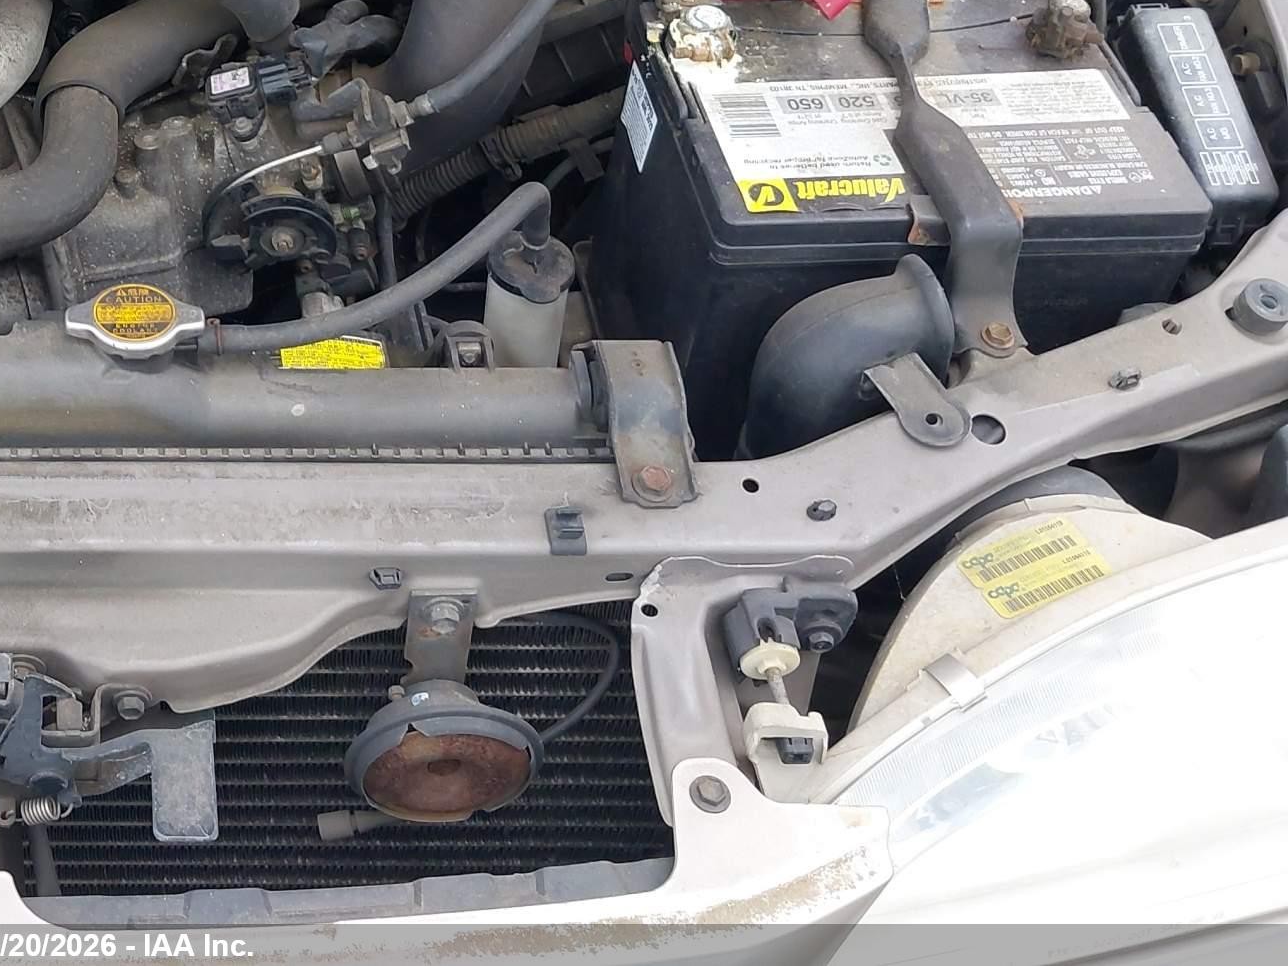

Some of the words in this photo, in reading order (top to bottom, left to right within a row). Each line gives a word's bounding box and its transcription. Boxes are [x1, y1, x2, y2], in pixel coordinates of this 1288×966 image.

[787, 97, 824, 111] 650
[838, 96, 875, 109] 520
[794, 177, 906, 203] Valucraft
[105, 295, 161, 303] CAUTION
